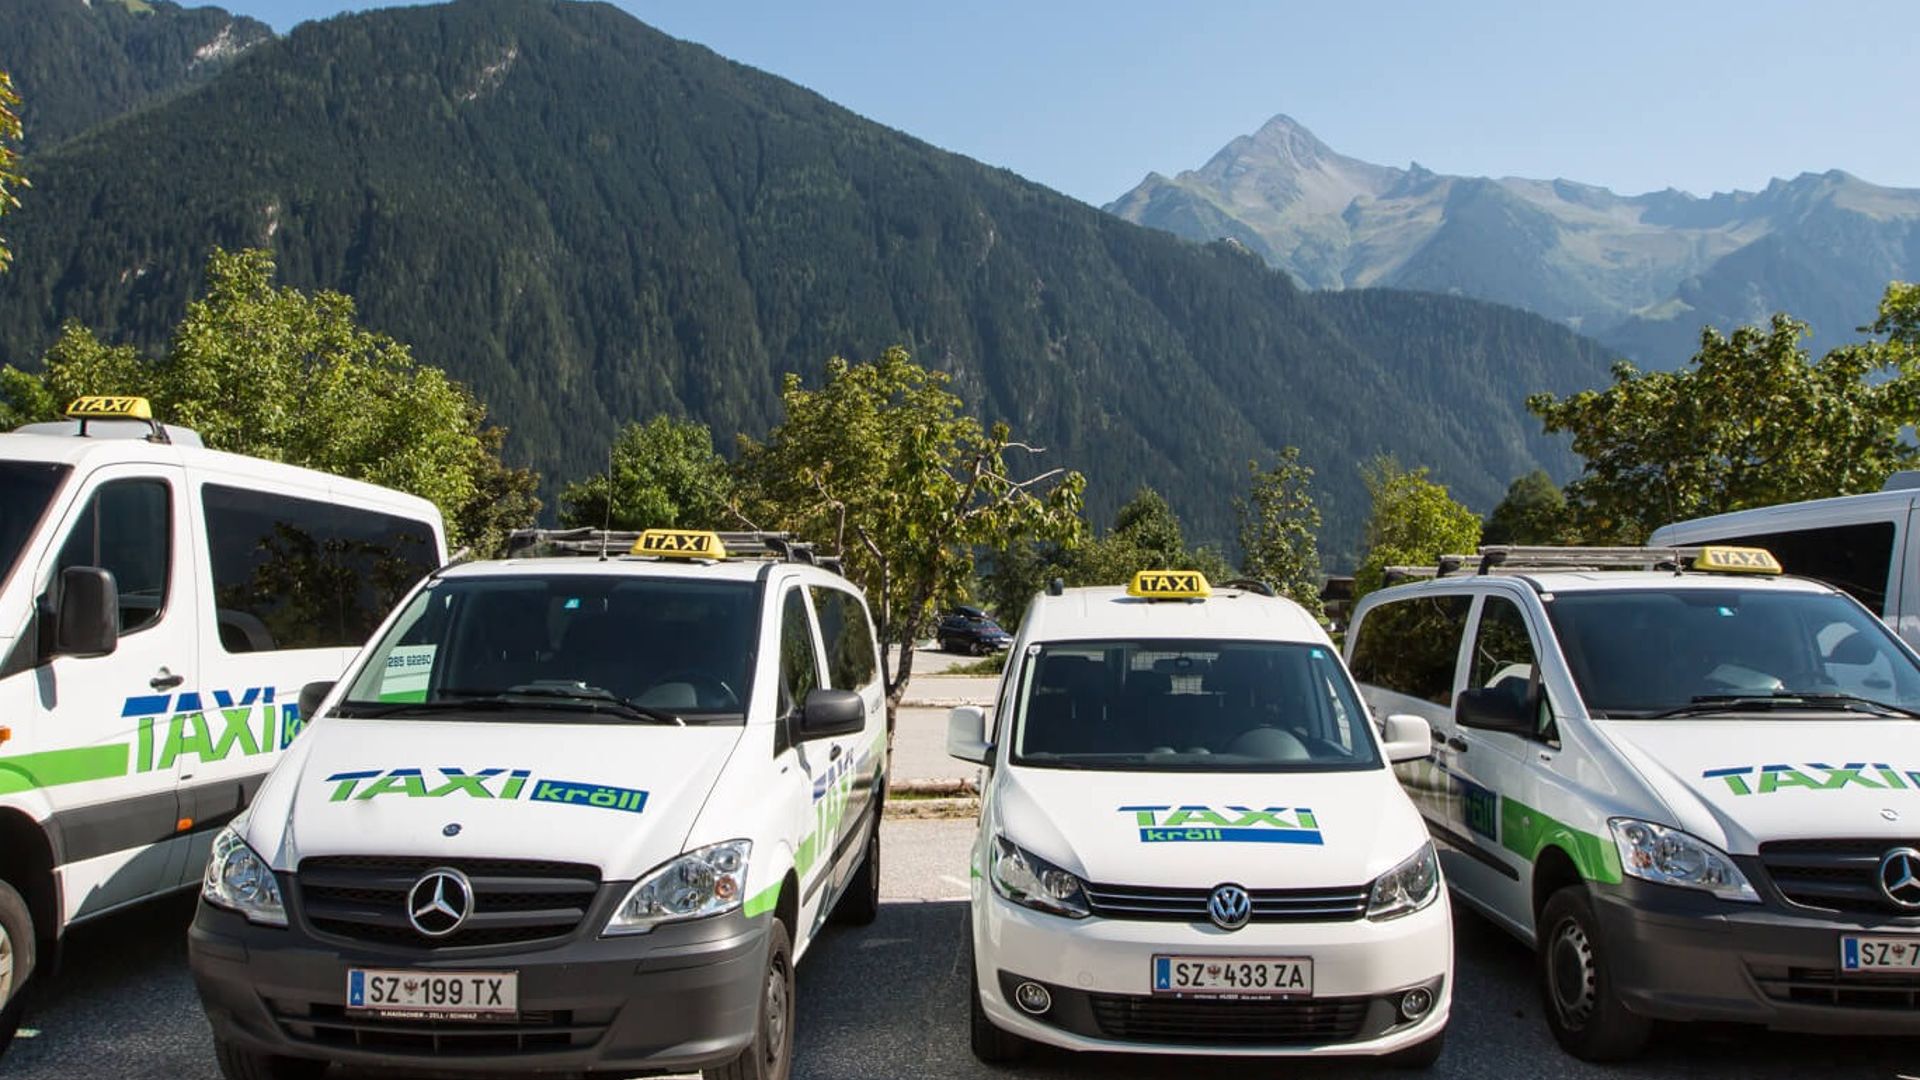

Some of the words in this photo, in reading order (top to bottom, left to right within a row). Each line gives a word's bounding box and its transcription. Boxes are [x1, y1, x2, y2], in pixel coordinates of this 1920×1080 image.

[78, 399, 135, 412] TAXI
[647, 533, 709, 551] TAXI
[1711, 550, 1772, 567] TAXI
[1141, 575, 1199, 591] TAXI
[121, 686, 276, 773] TAXI
[324, 767, 531, 802] TAXI
[536, 781, 642, 811] kröll
[1702, 762, 1908, 796] TAXI
[1117, 805, 1319, 829] TAXI
[1147, 828, 1222, 840] kröll
[1862, 943, 1889, 966] SZ
[1176, 963, 1204, 987] SZ
[1224, 964, 1268, 987] 433
[1274, 965, 1304, 988] ZA
[371, 976, 399, 1003] SZ
[421, 978, 463, 1005] 199
[472, 979, 502, 1005] TX
